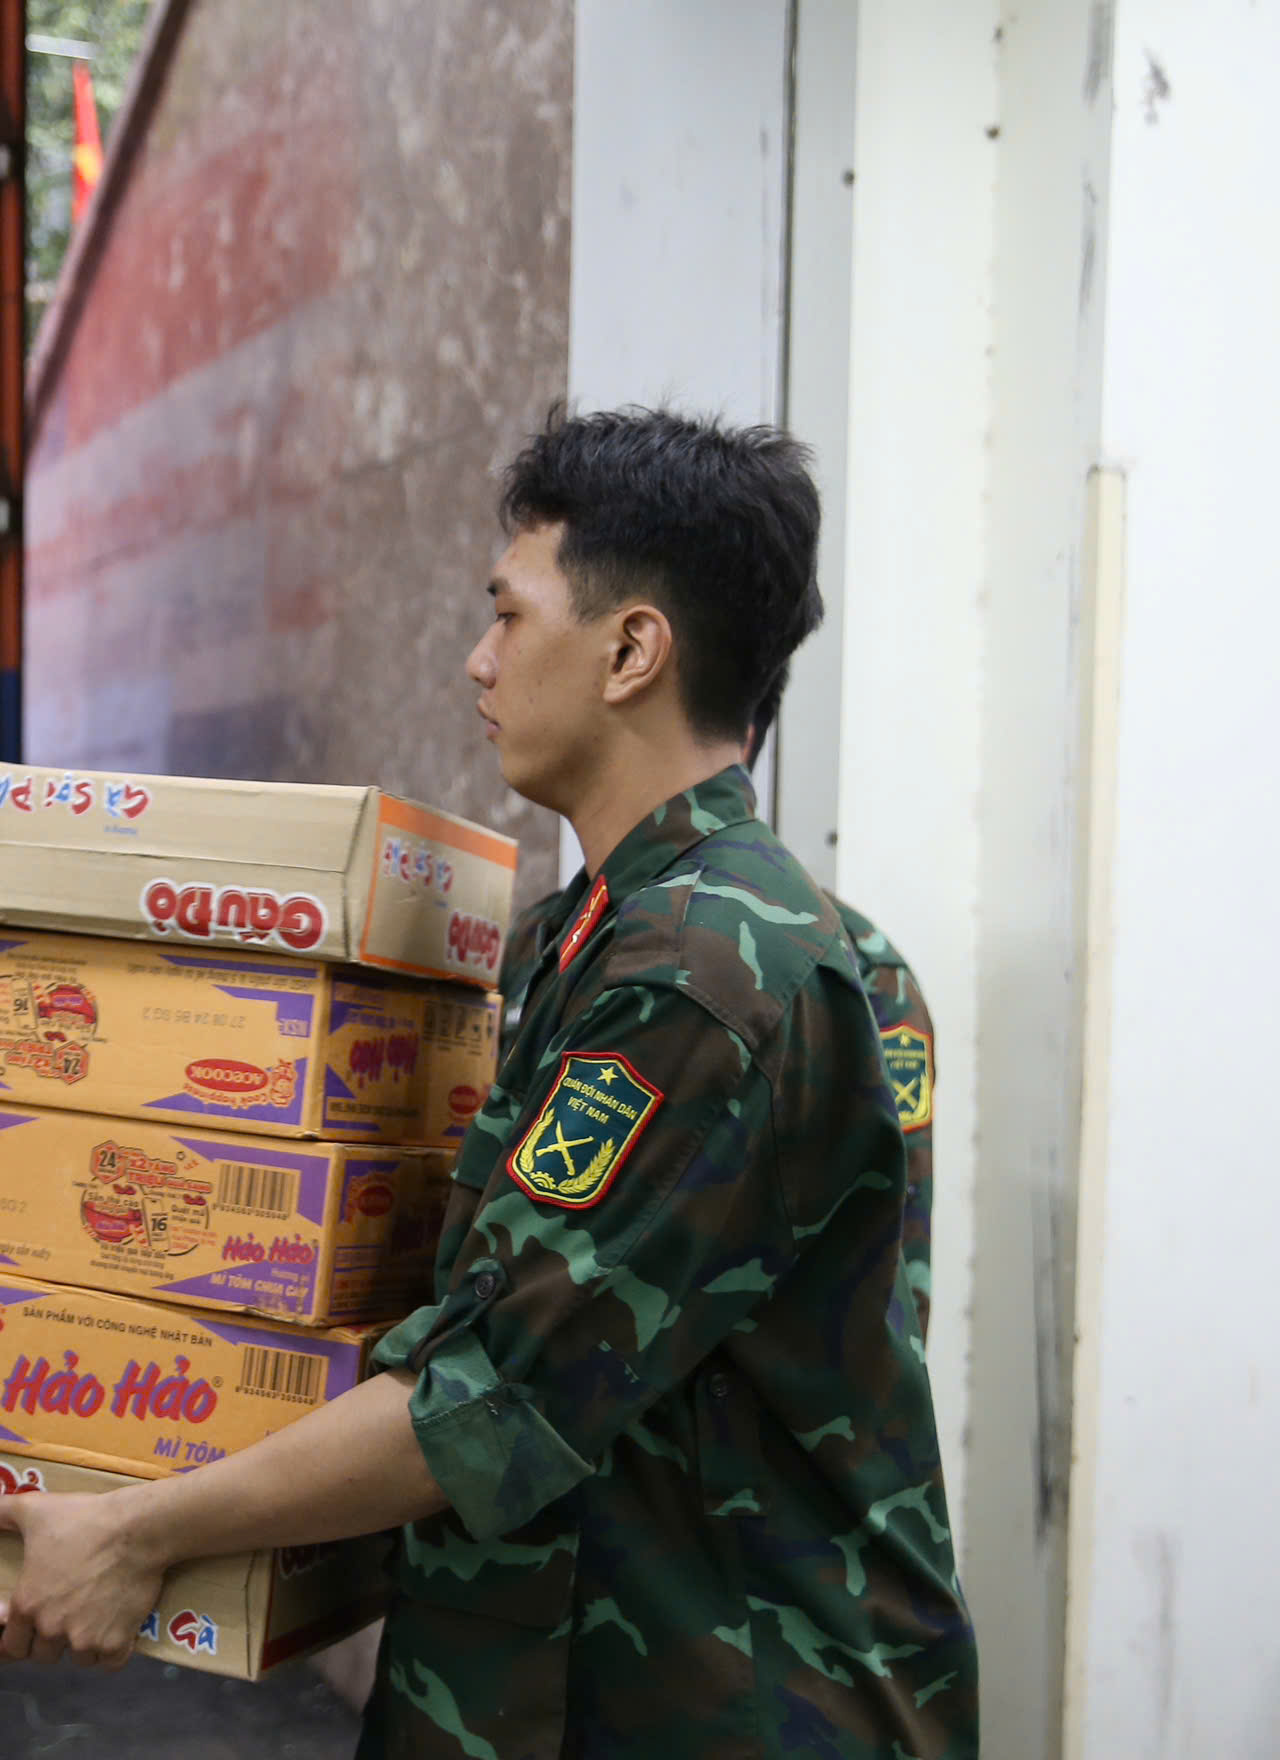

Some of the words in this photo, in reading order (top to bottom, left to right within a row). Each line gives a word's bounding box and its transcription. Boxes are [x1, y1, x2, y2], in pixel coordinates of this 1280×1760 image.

[586, 1106, 610, 1125] NAM
[98, 1149, 116, 1169] 24
[149, 1215, 168, 1233] 16
[22, 1305, 43, 1318] SẢN
[45, 1307, 76, 1324] PHẨM
[76, 1314, 95, 1328] VỚI
[96, 1316, 126, 1333] CÔNG
[128, 1323, 158, 1339] NGHỆ
[159, 1327, 189, 1344] NHẬT
[190, 1333, 213, 1348] BẢN
[1, 1349, 106, 1419] Hảo
[111, 1354, 219, 1425] Hảo
[153, 1436, 182, 1459] MÌ
[167, 1609, 216, 1651] Gà
